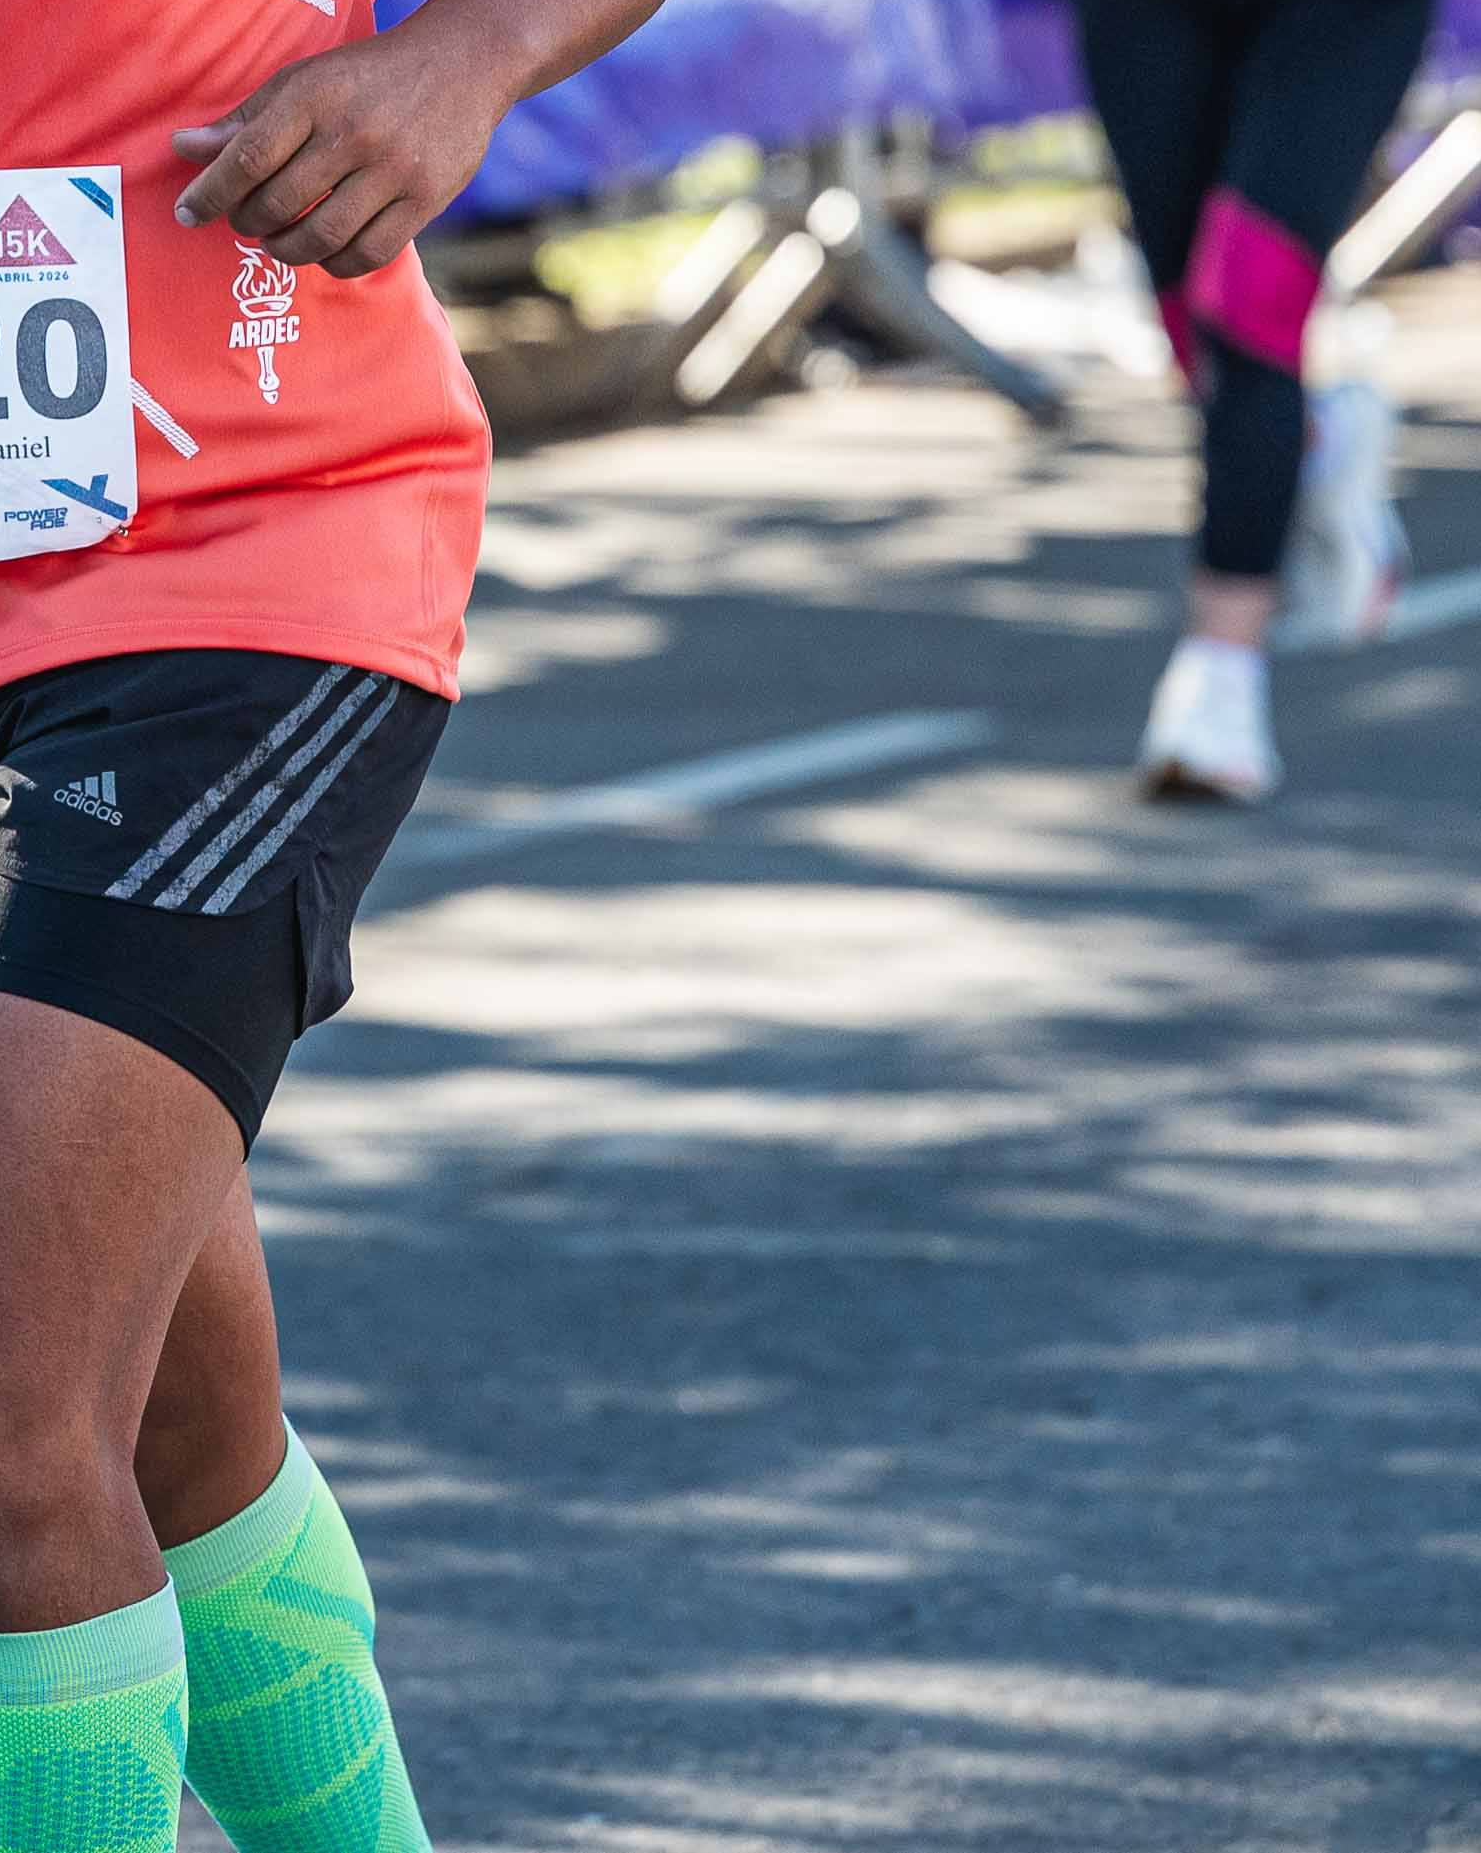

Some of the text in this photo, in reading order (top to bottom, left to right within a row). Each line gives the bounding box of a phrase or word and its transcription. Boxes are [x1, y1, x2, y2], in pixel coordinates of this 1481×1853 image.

[38, 270, 70, 282] 2026
[229, 315, 301, 349] ARDEC
[53, 788, 124, 826] adidas
